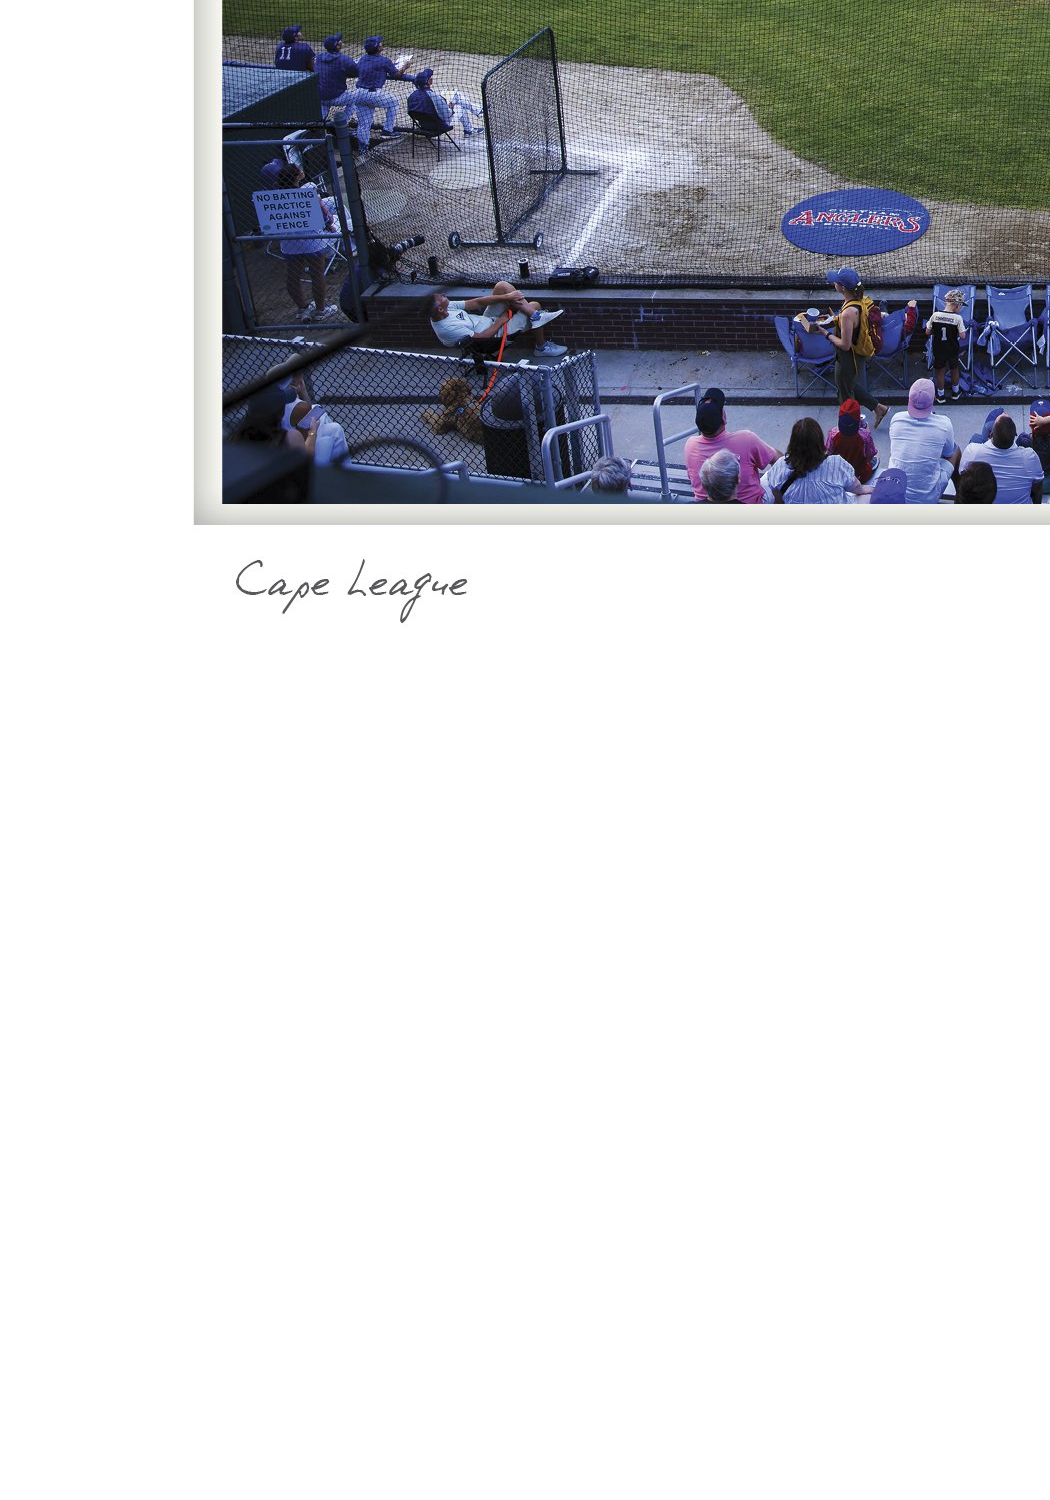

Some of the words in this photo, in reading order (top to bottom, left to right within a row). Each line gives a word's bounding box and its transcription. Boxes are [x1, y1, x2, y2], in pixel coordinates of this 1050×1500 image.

[280, 46, 292, 60] 11
[256, 194, 271, 202] NO
[272, 191, 314, 201] BATTING
[263, 201, 312, 211] PRACTICE
[269, 211, 311, 221] AGAINST
[788, 209, 921, 233] ANGLERS
[276, 221, 309, 230] FENCE
[941, 327, 947, 340] 1
